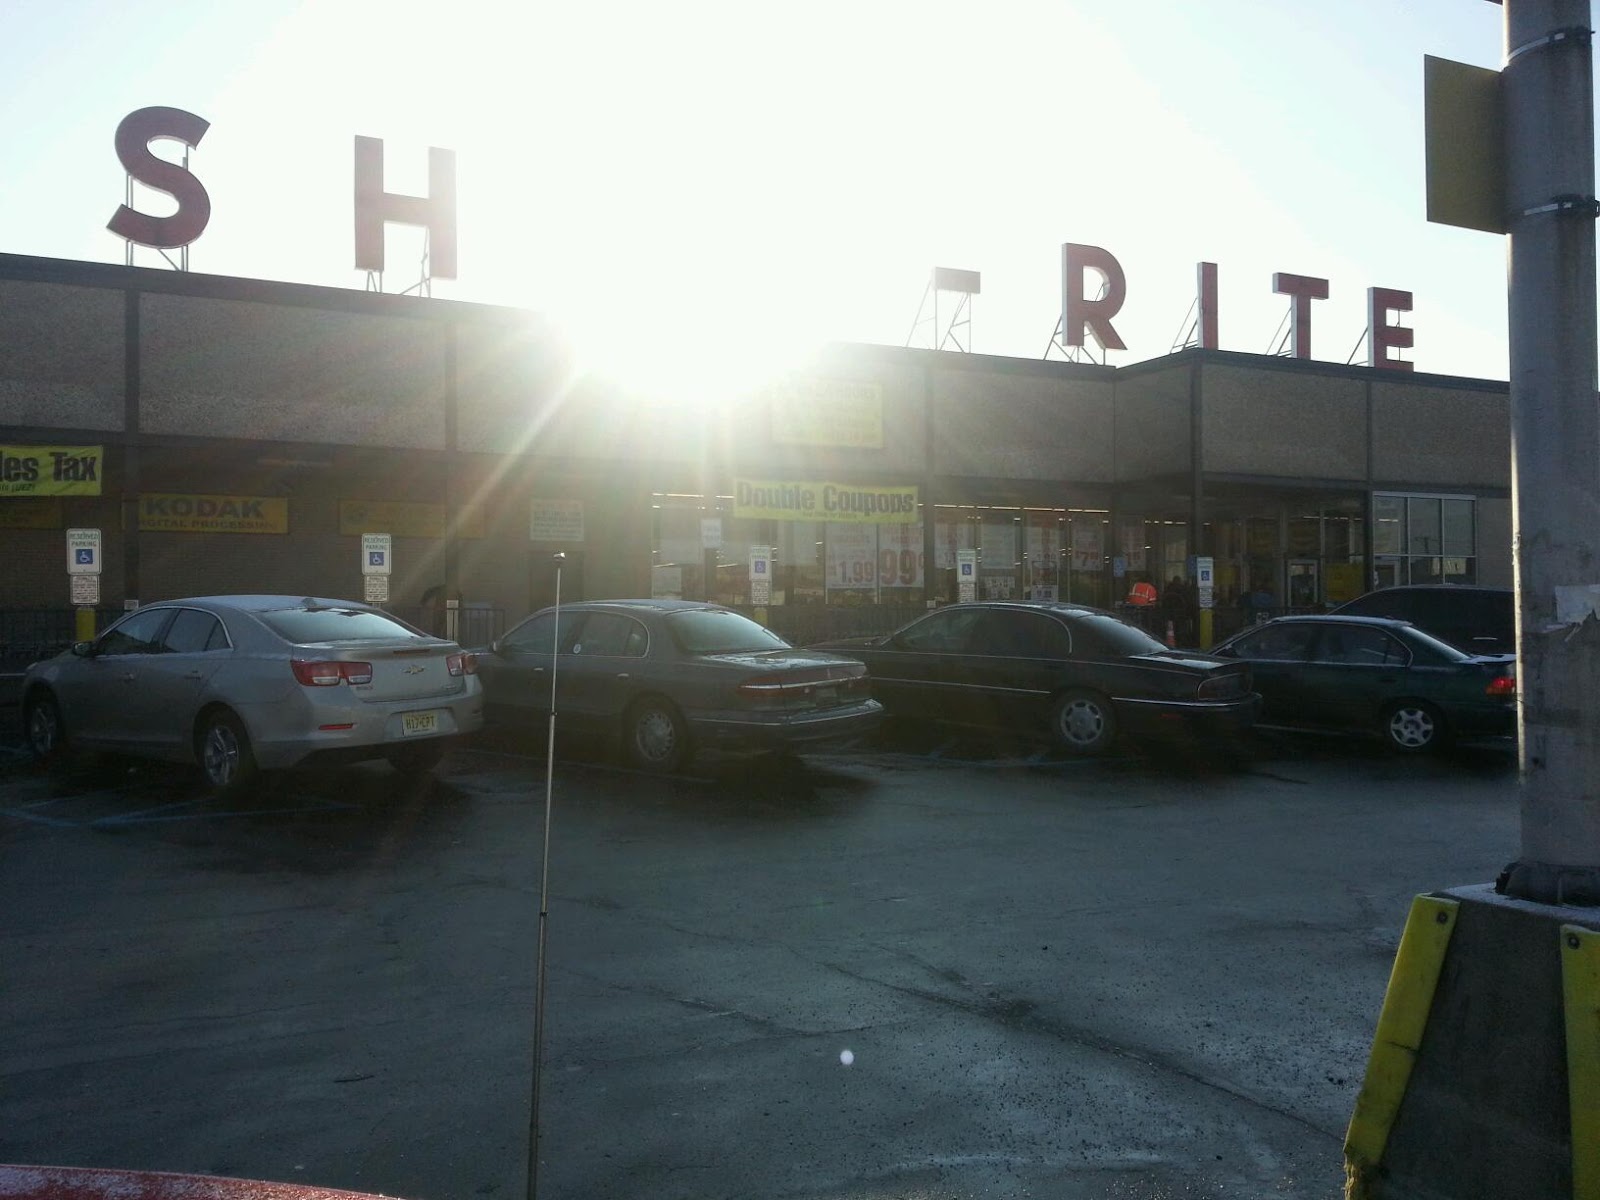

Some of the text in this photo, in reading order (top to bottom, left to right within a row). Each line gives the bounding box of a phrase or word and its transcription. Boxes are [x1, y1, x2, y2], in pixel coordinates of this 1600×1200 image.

[49, 452, 97, 481] Tax
[144, 497, 264, 518] KODAK
[737, 481, 915, 516] Double Coupons
